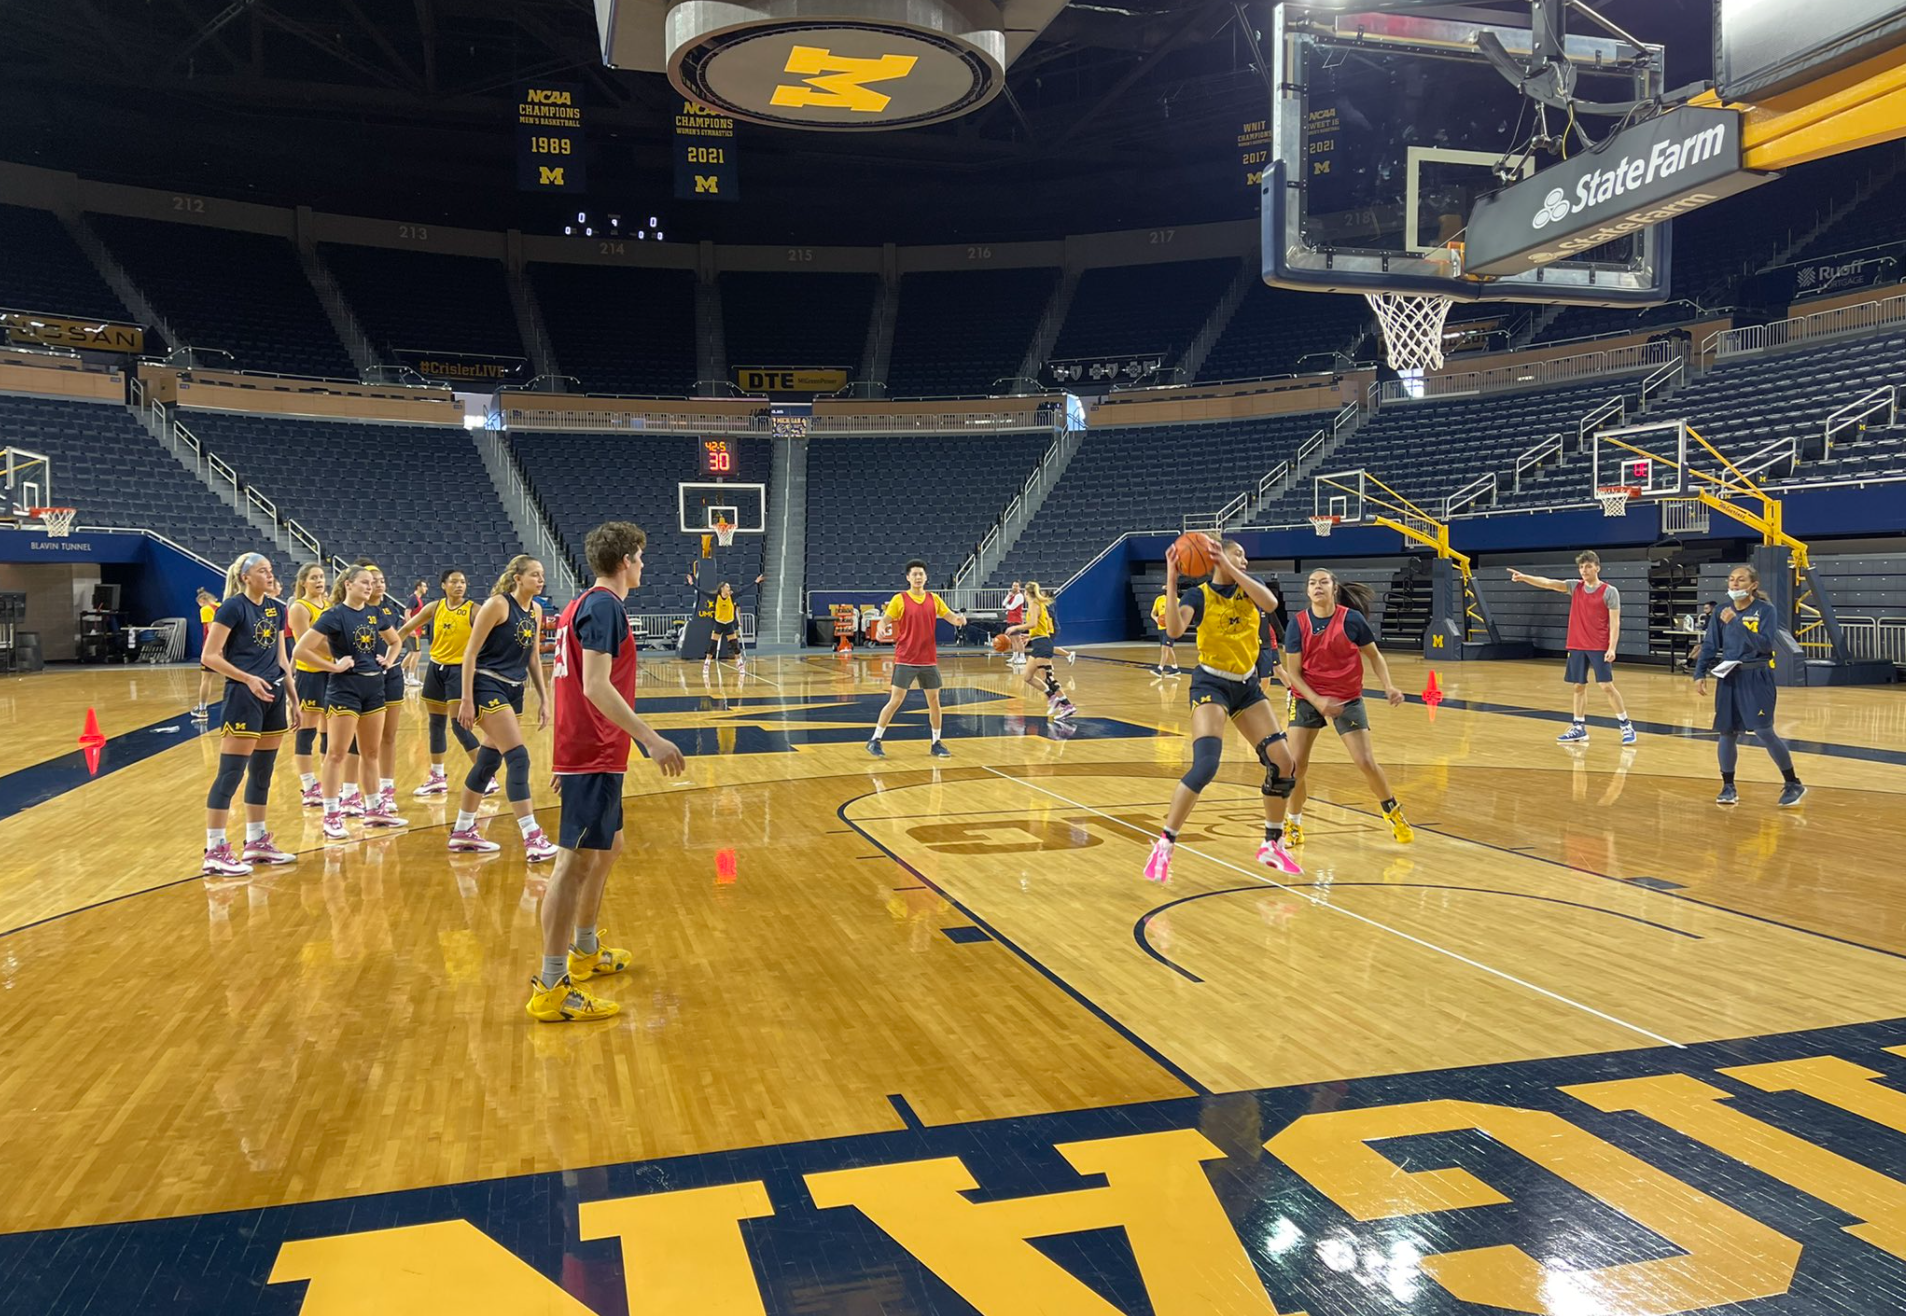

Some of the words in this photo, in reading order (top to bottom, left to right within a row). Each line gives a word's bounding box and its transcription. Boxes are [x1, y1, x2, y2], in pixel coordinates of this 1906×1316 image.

[770, 45, 919, 112] M
[527, 89, 571, 105] NCAA
[519, 103, 580, 119] CHAMPIONS
[683, 101, 724, 116] NCA
[540, 117, 580, 128] BASKETBALL
[675, 115, 733, 129] CHAMPIONS
[1243, 120, 1266, 133] WNIT
[1307, 119, 1331, 130] WEET
[531, 136, 571, 155] 1989
[1310, 139, 1335, 154] 2021
[688, 146, 724, 164] 2021
[1243, 150, 1267, 164] 2017
[1314, 160, 1330, 175] M
[539, 166, 564, 185] M
[694, 175, 718, 193] M
[172, 196, 205, 213] 212
[1344, 211, 1371, 226] 218
[399, 225, 427, 240] 213
[1150, 229, 1175, 244] 217
[600, 242, 624, 254] 214
[788, 249, 812, 262] 215
[968, 247, 991, 259] 216
[420, 360, 505, 378] #CrislerLIVE
[749, 373, 794, 389] DTE
[709, 452, 730, 471] 30
[30, 541, 58, 550] BLAVIN
[61, 542, 91, 551] TUNNEL
[456, 608, 467, 616] 00
[1432, 634, 1443, 648] M
